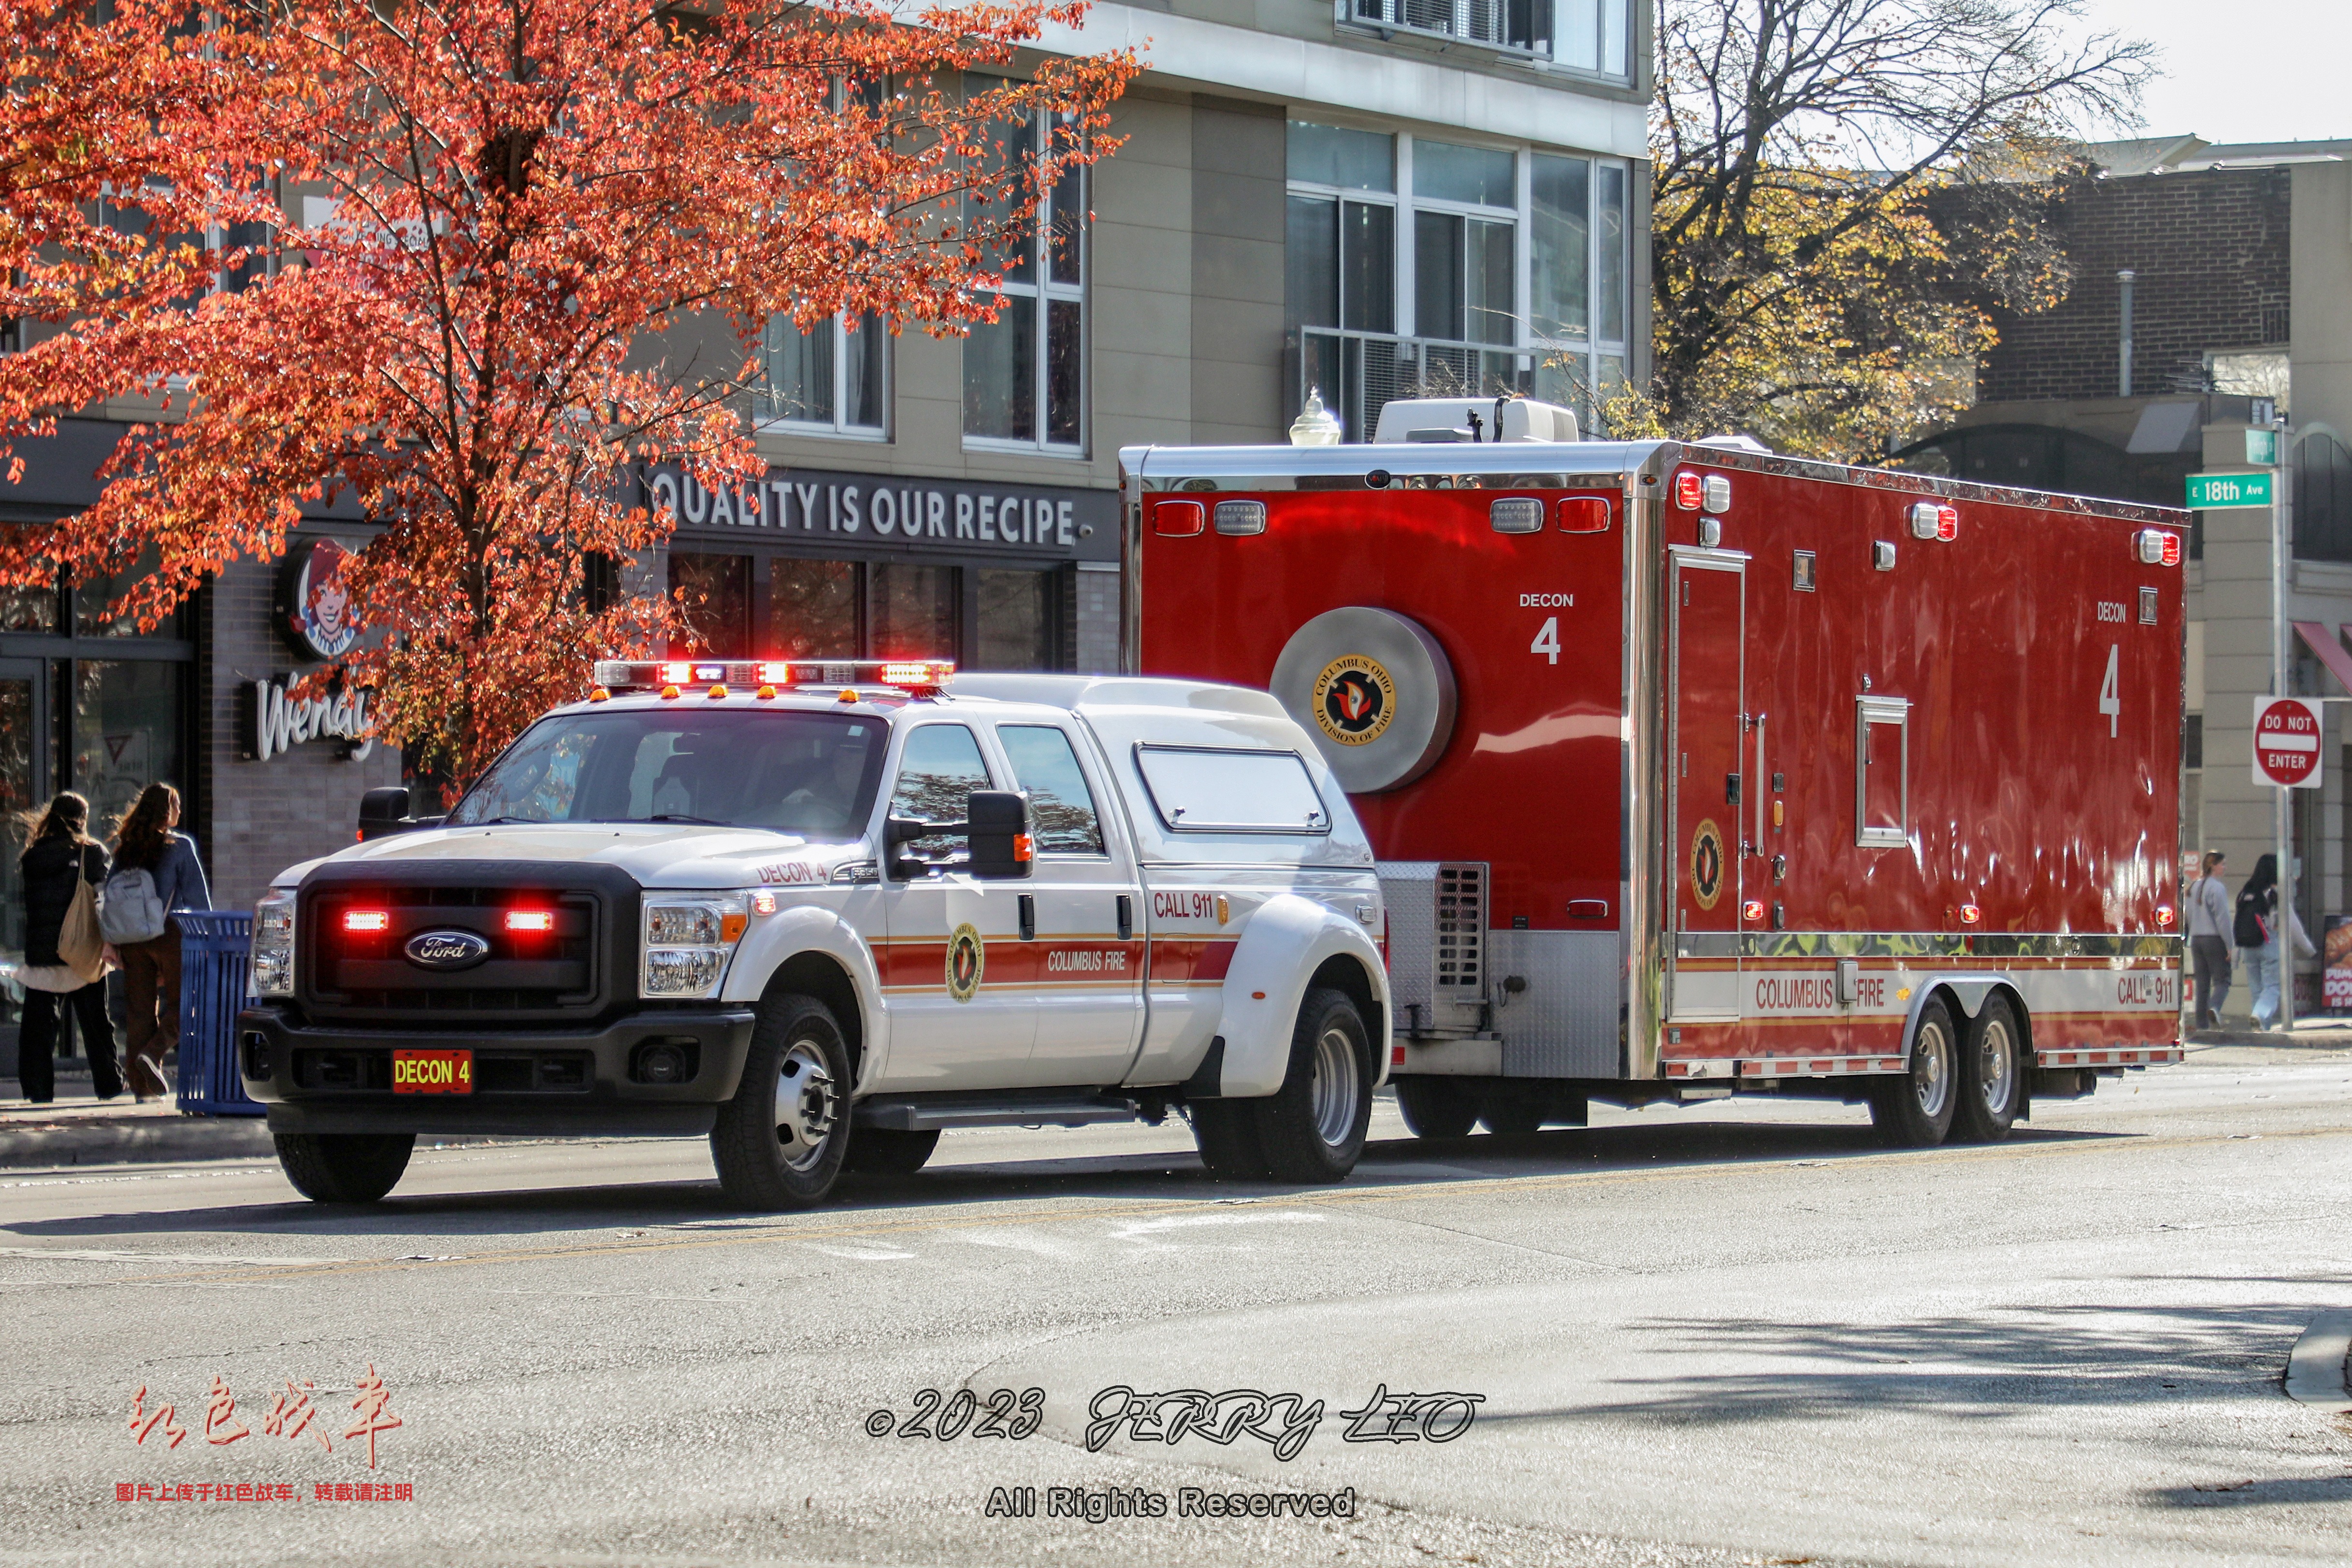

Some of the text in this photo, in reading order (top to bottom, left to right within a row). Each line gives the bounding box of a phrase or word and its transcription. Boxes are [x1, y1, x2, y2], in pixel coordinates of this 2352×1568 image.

[2192, 481, 2263, 501] E 18th Ave
[652, 473, 1074, 546] QUALITY IS OUR RECIPE
[1520, 593, 1573, 607] DECON
[2097, 602, 2126, 623] DECON
[1530, 617, 1561, 665] 4
[1316, 659, 1392, 696] COLUMBUS OHIO
[2099, 644, 2120, 738] 4
[256, 666, 378, 762] Wendy
[1317, 706, 1392, 743] DIVISION OF FIRE
[2265, 716, 2311, 731] DO NOT
[2268, 754, 2306, 769] ENTER
[756, 862, 826, 883] DECON 4
[1154, 893, 1213, 919] CALL 911
[420, 936, 466, 960] Ford
[1048, 951, 1125, 972] COLUMBUS FIRE
[1756, 978, 1884, 1009] COLUMBUS FIRE
[2117, 977, 2146, 1004] CALL
[2155, 977, 2173, 1004] 911
[394, 1060, 470, 1083] DECON 4
